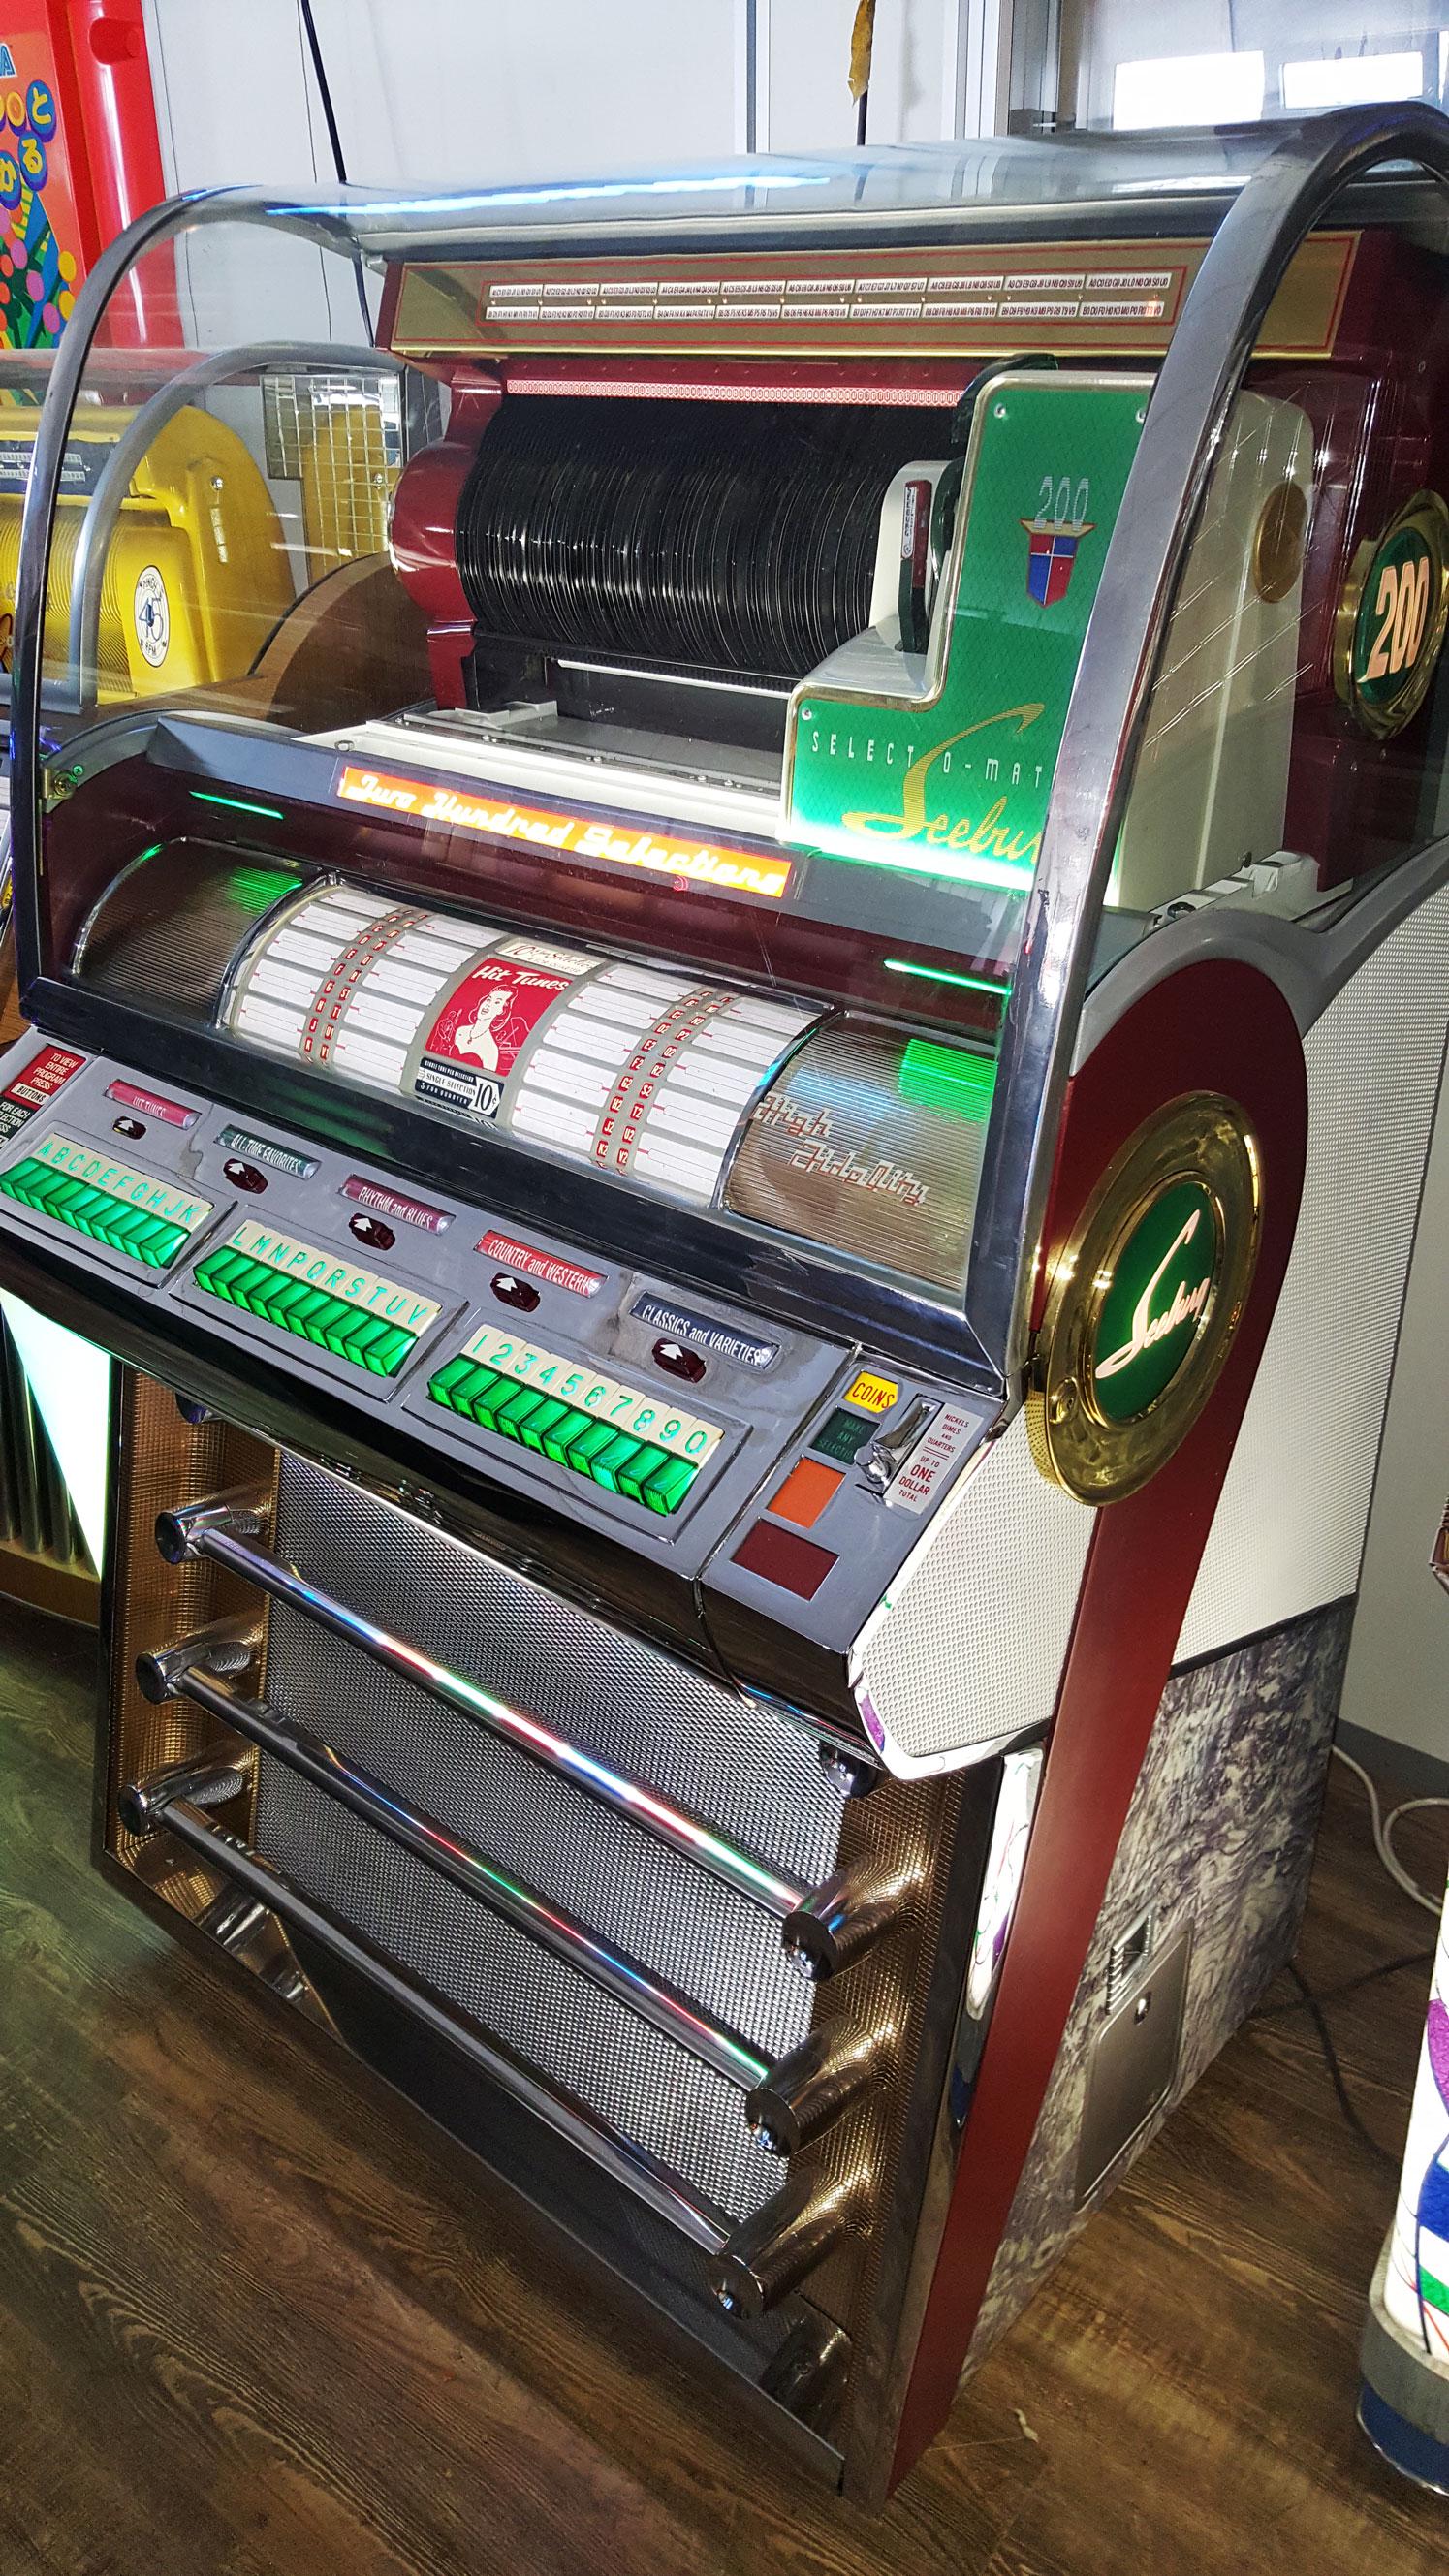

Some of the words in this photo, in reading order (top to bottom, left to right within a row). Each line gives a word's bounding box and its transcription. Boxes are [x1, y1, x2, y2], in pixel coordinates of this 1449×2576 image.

[1033, 476, 1089, 531] 200
[1357, 556, 1430, 683] 200
[346, 774, 417, 809] Two
[421, 791, 574, 846] Hundred
[574, 826, 786, 894] Selections
[472, 965, 512, 981] Hit
[512, 971, 569, 990] Tunes
[677, 1030, 689, 1040] P2
[644, 1039, 656, 1051] E2
[50, 1052, 61, 1062] TO
[60, 1056, 79, 1069] VIEW
[632, 1058, 645, 1069] F2
[33, 1066, 66, 1084] PROGRAM
[45, 1061, 69, 1076] ENTIRE
[651, 1065, 664, 1076] R2
[30, 1077, 53, 1090] PRESS
[426, 1072, 445, 1085] SINGLE
[447, 1081, 476, 1096] SELECTION
[621, 1077, 633, 1089] G2
[16, 1086, 47, 1103] BUTTONS
[641, 1084, 652, 1097] S2
[612, 1098, 623, 1111] H2
[631, 1105, 643, 1117] T2
[11, 1107, 31, 1120] EACH
[604, 1119, 614, 1132] J2
[623, 1128, 635, 1141] U2
[598, 1143, 609, 1156] K2
[618, 1150, 629, 1163] V2
[359, 1187, 392, 1213] RHYTHM
[393, 1201, 406, 1218] and
[408, 1208, 433, 1230] BLUES
[488, 1239, 528, 1264] COUNTRY
[530, 1257, 546, 1274] and
[546, 1263, 590, 1295] WESTERN
[642, 1304, 690, 1336] CLASSICS
[689, 1327, 709, 1344] and
[709, 1331, 763, 1367] VARIETIES
[852, 1382, 895, 1409] COINS
[944, 1414, 969, 1428] NICKELS
[942, 1424, 961, 1435] DIMES
[819, 1439, 854, 1460] SELECTIO
[928, 1437, 956, 1453] QUARTERS
[910, 1464, 936, 1483] ONE
[898, 1476, 930, 1495] DOLLAR
[898, 1489, 918, 1502] TOTAL
